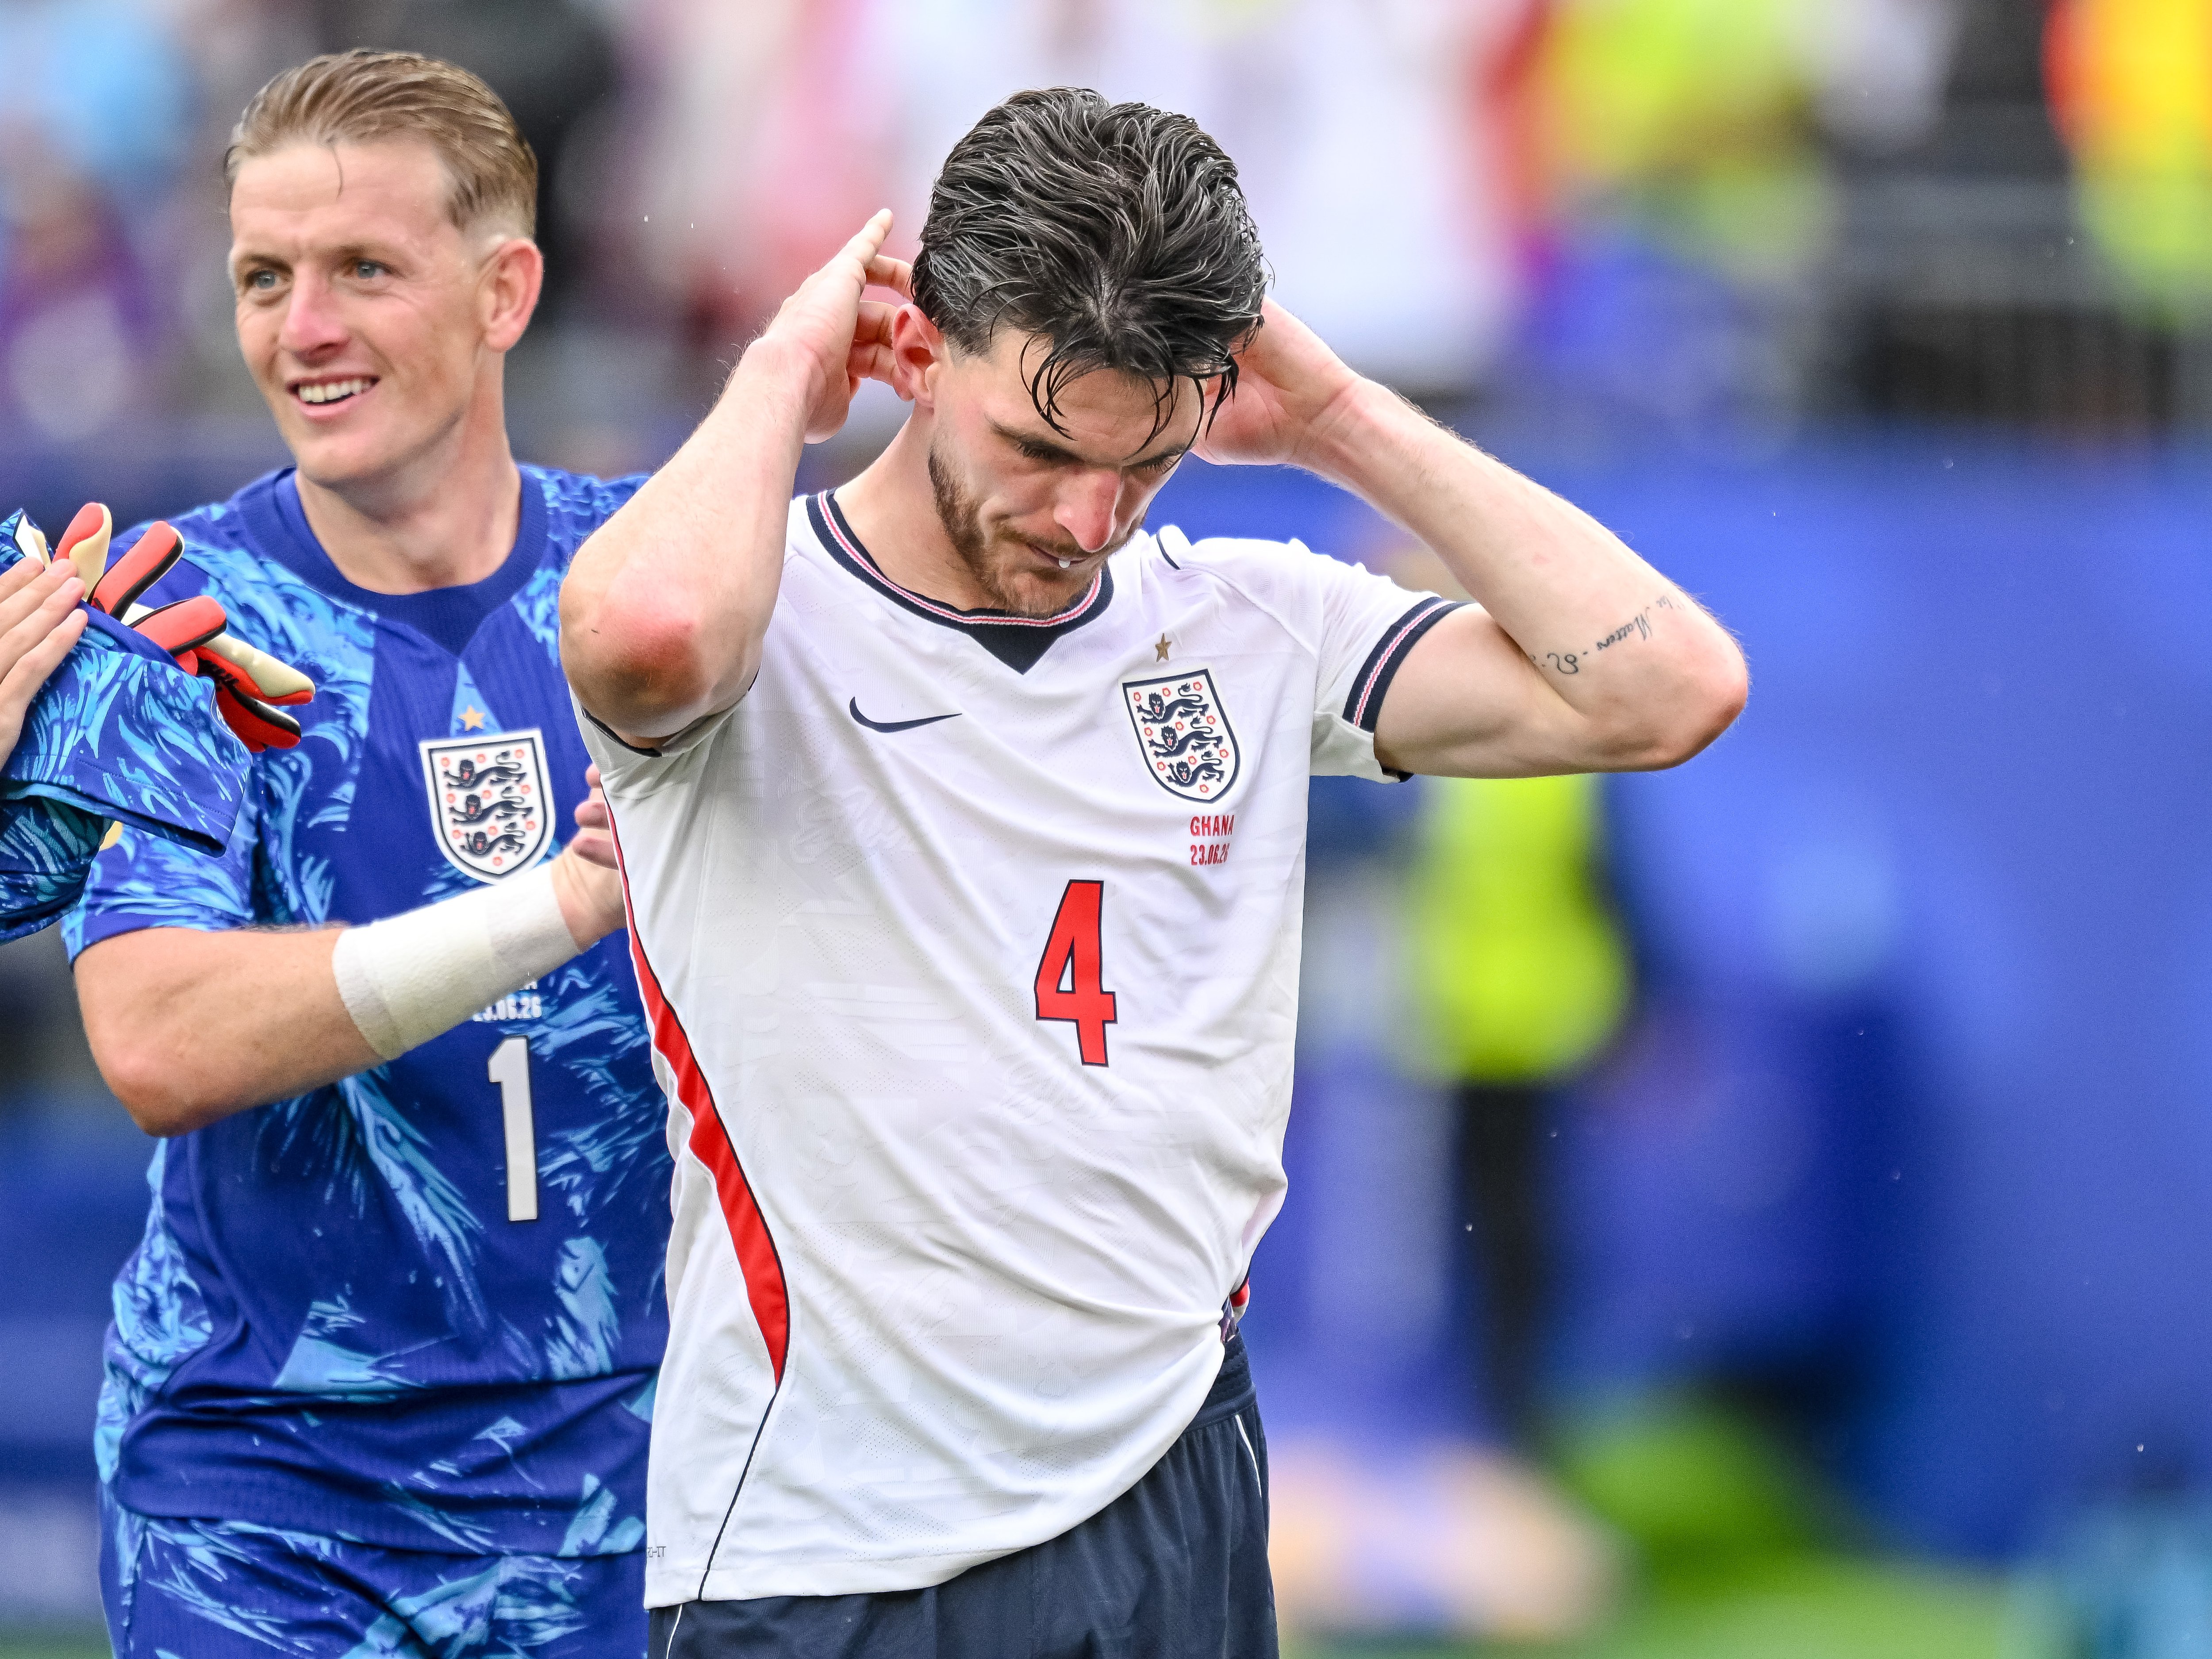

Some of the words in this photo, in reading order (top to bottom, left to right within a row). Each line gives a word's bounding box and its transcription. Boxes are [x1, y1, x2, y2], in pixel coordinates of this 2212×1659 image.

[1190, 815, 1235, 836] GHANA
[1190, 843, 1230, 865] 23.06.26
[1034, 879, 1118, 1068] 4
[488, 1036, 537, 1221] 1
